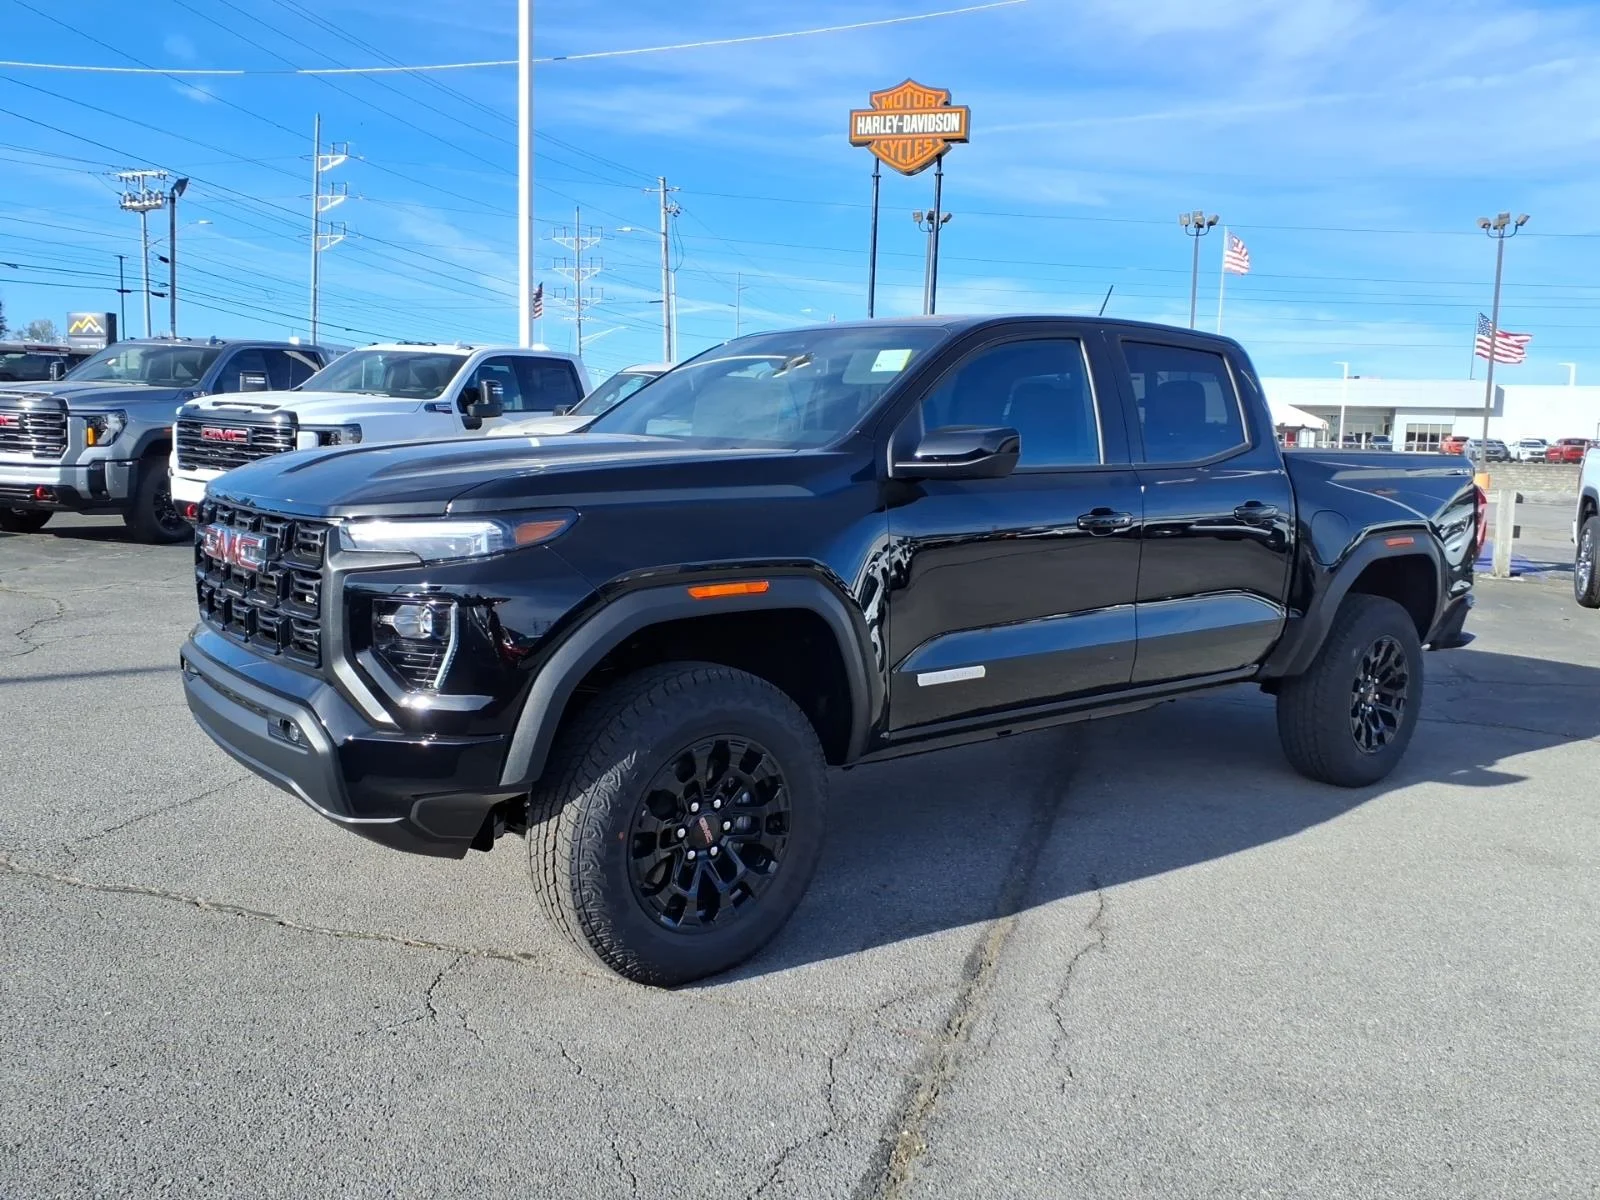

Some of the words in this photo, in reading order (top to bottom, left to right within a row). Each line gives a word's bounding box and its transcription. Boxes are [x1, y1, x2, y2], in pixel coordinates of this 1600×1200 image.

[881, 87, 936, 109] MOTOR
[856, 112, 960, 135] HARLEY-DAVIDSON
[880, 139, 934, 164] CYCLES
[202, 427, 248, 442] GMC
[203, 526, 264, 571] GMC
